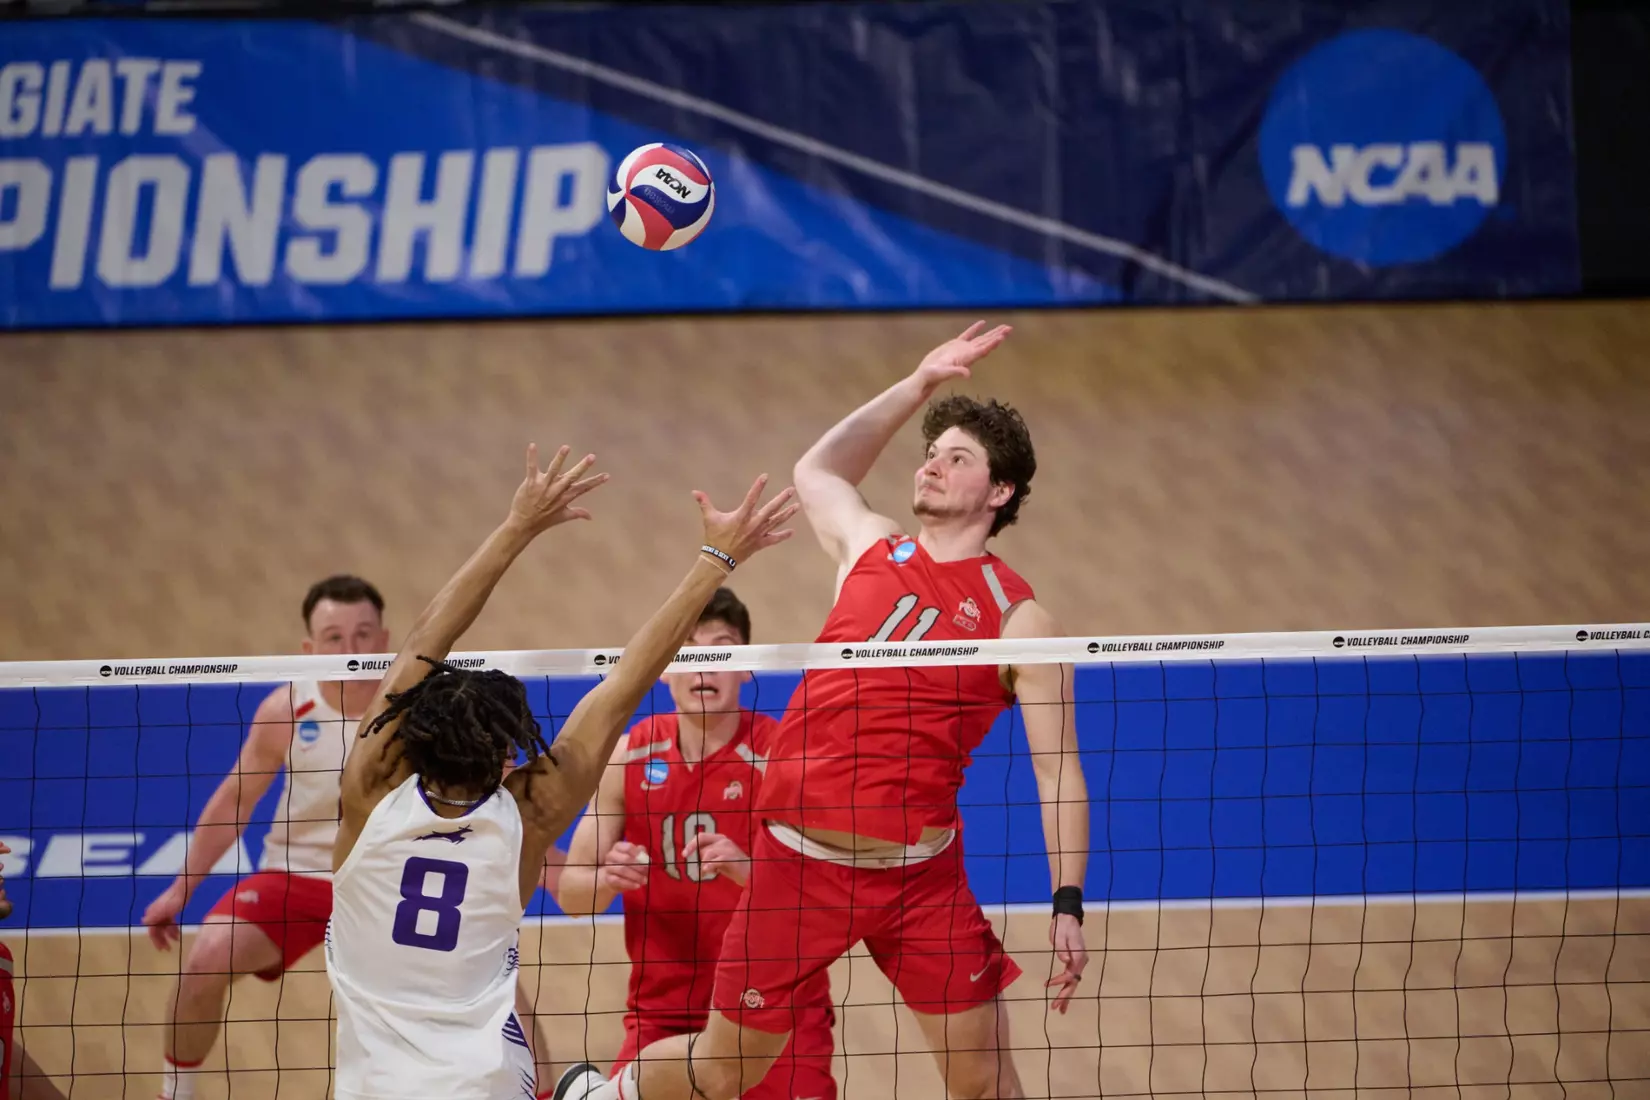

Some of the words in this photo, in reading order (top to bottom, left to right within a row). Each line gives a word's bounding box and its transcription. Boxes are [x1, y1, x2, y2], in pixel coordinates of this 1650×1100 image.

[0, 58, 203, 138] GIATE
[1286, 141, 1499, 208] NCAA
[655, 168, 691, 199] NCAA
[865, 593, 941, 642] 11
[1346, 636, 1399, 647] VOLLEYBALL
[1400, 634, 1470, 645] CHAMPIONSHIP
[1590, 630, 1642, 640] VOLLEYBALL
[855, 648, 907, 658] VOLLEYBALL
[909, 646, 979, 657] CHAMPIONSHIP
[1101, 642, 1153, 652] VOLLEYBALL
[1155, 640, 1225, 650] CHAMPIONSHIP
[671, 652, 732, 663] AMPIONSHIP
[114, 665, 166, 676] VOLLEYBALL
[168, 664, 238, 675] CHAMPIONSHIP
[392, 856, 469, 952] 8
